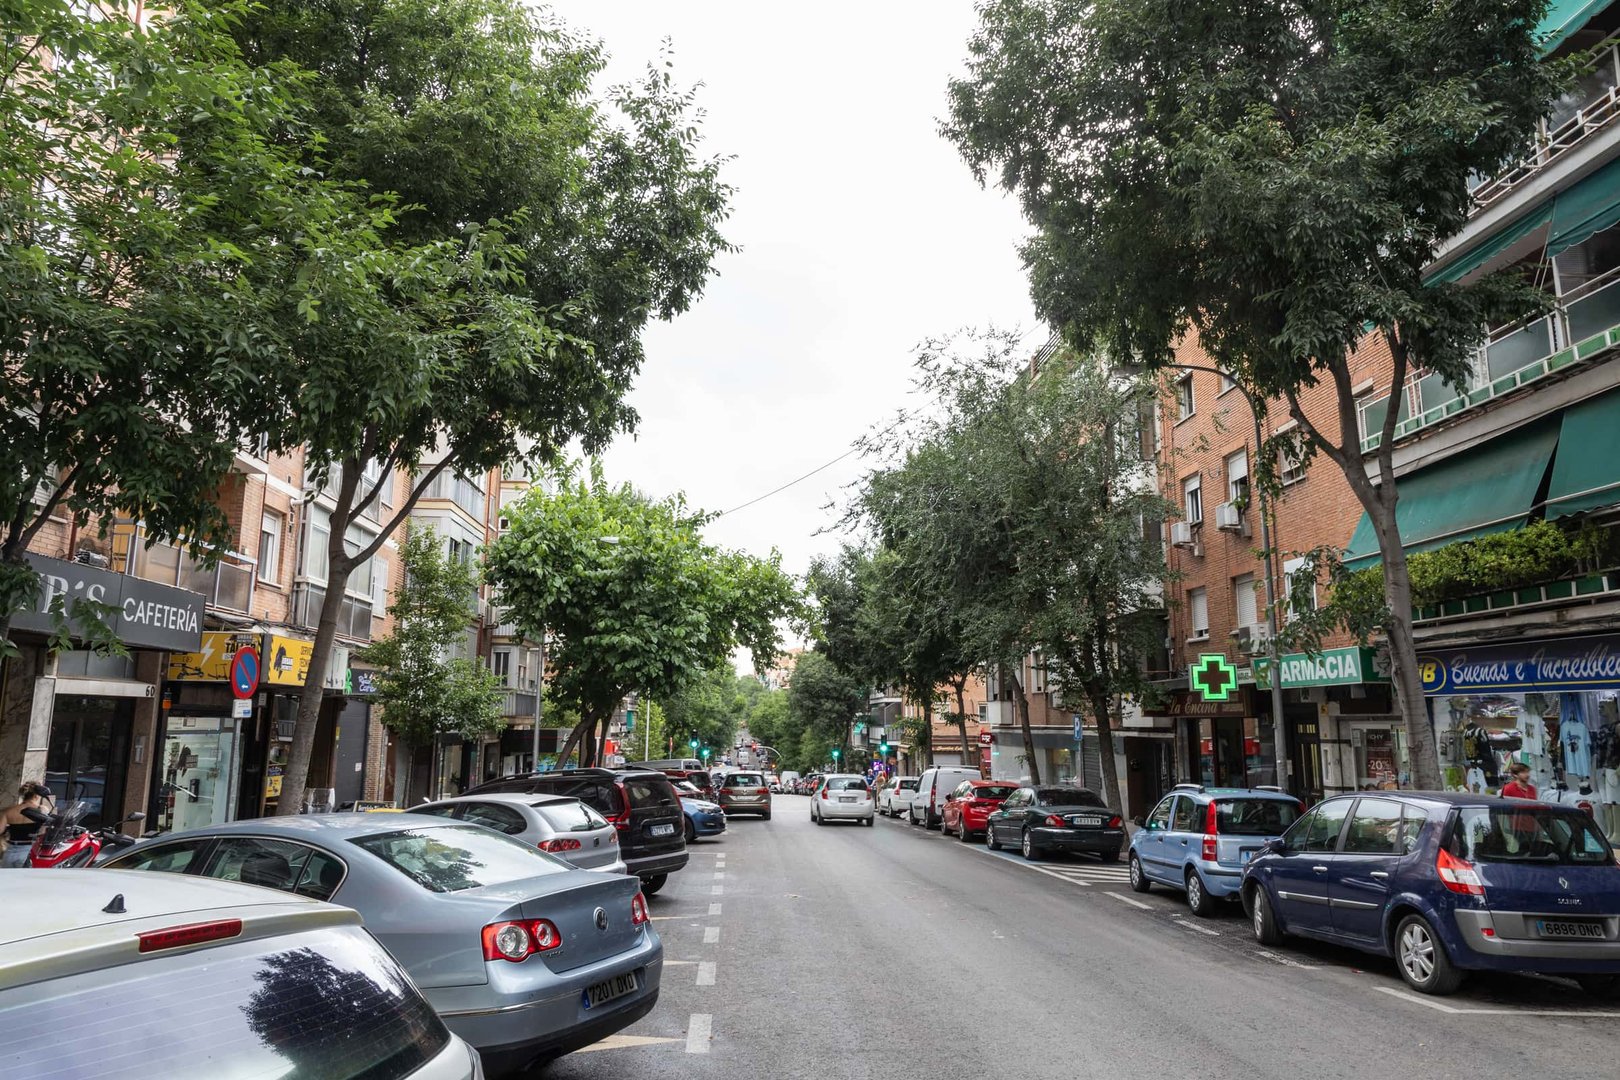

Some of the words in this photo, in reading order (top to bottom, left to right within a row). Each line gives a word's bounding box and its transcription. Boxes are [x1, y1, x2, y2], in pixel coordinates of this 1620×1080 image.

[123, 597, 198, 633] CAFETERÍA
[1280, 654, 1358, 682] ARMACIA
[1451, 654, 1510, 684] Buenas
[1514, 661, 1525, 680] e
[1545, 923, 1576, 935] 6896
[1580, 925, 1602, 937] DNC
[589, 979, 615, 1004] 7201
